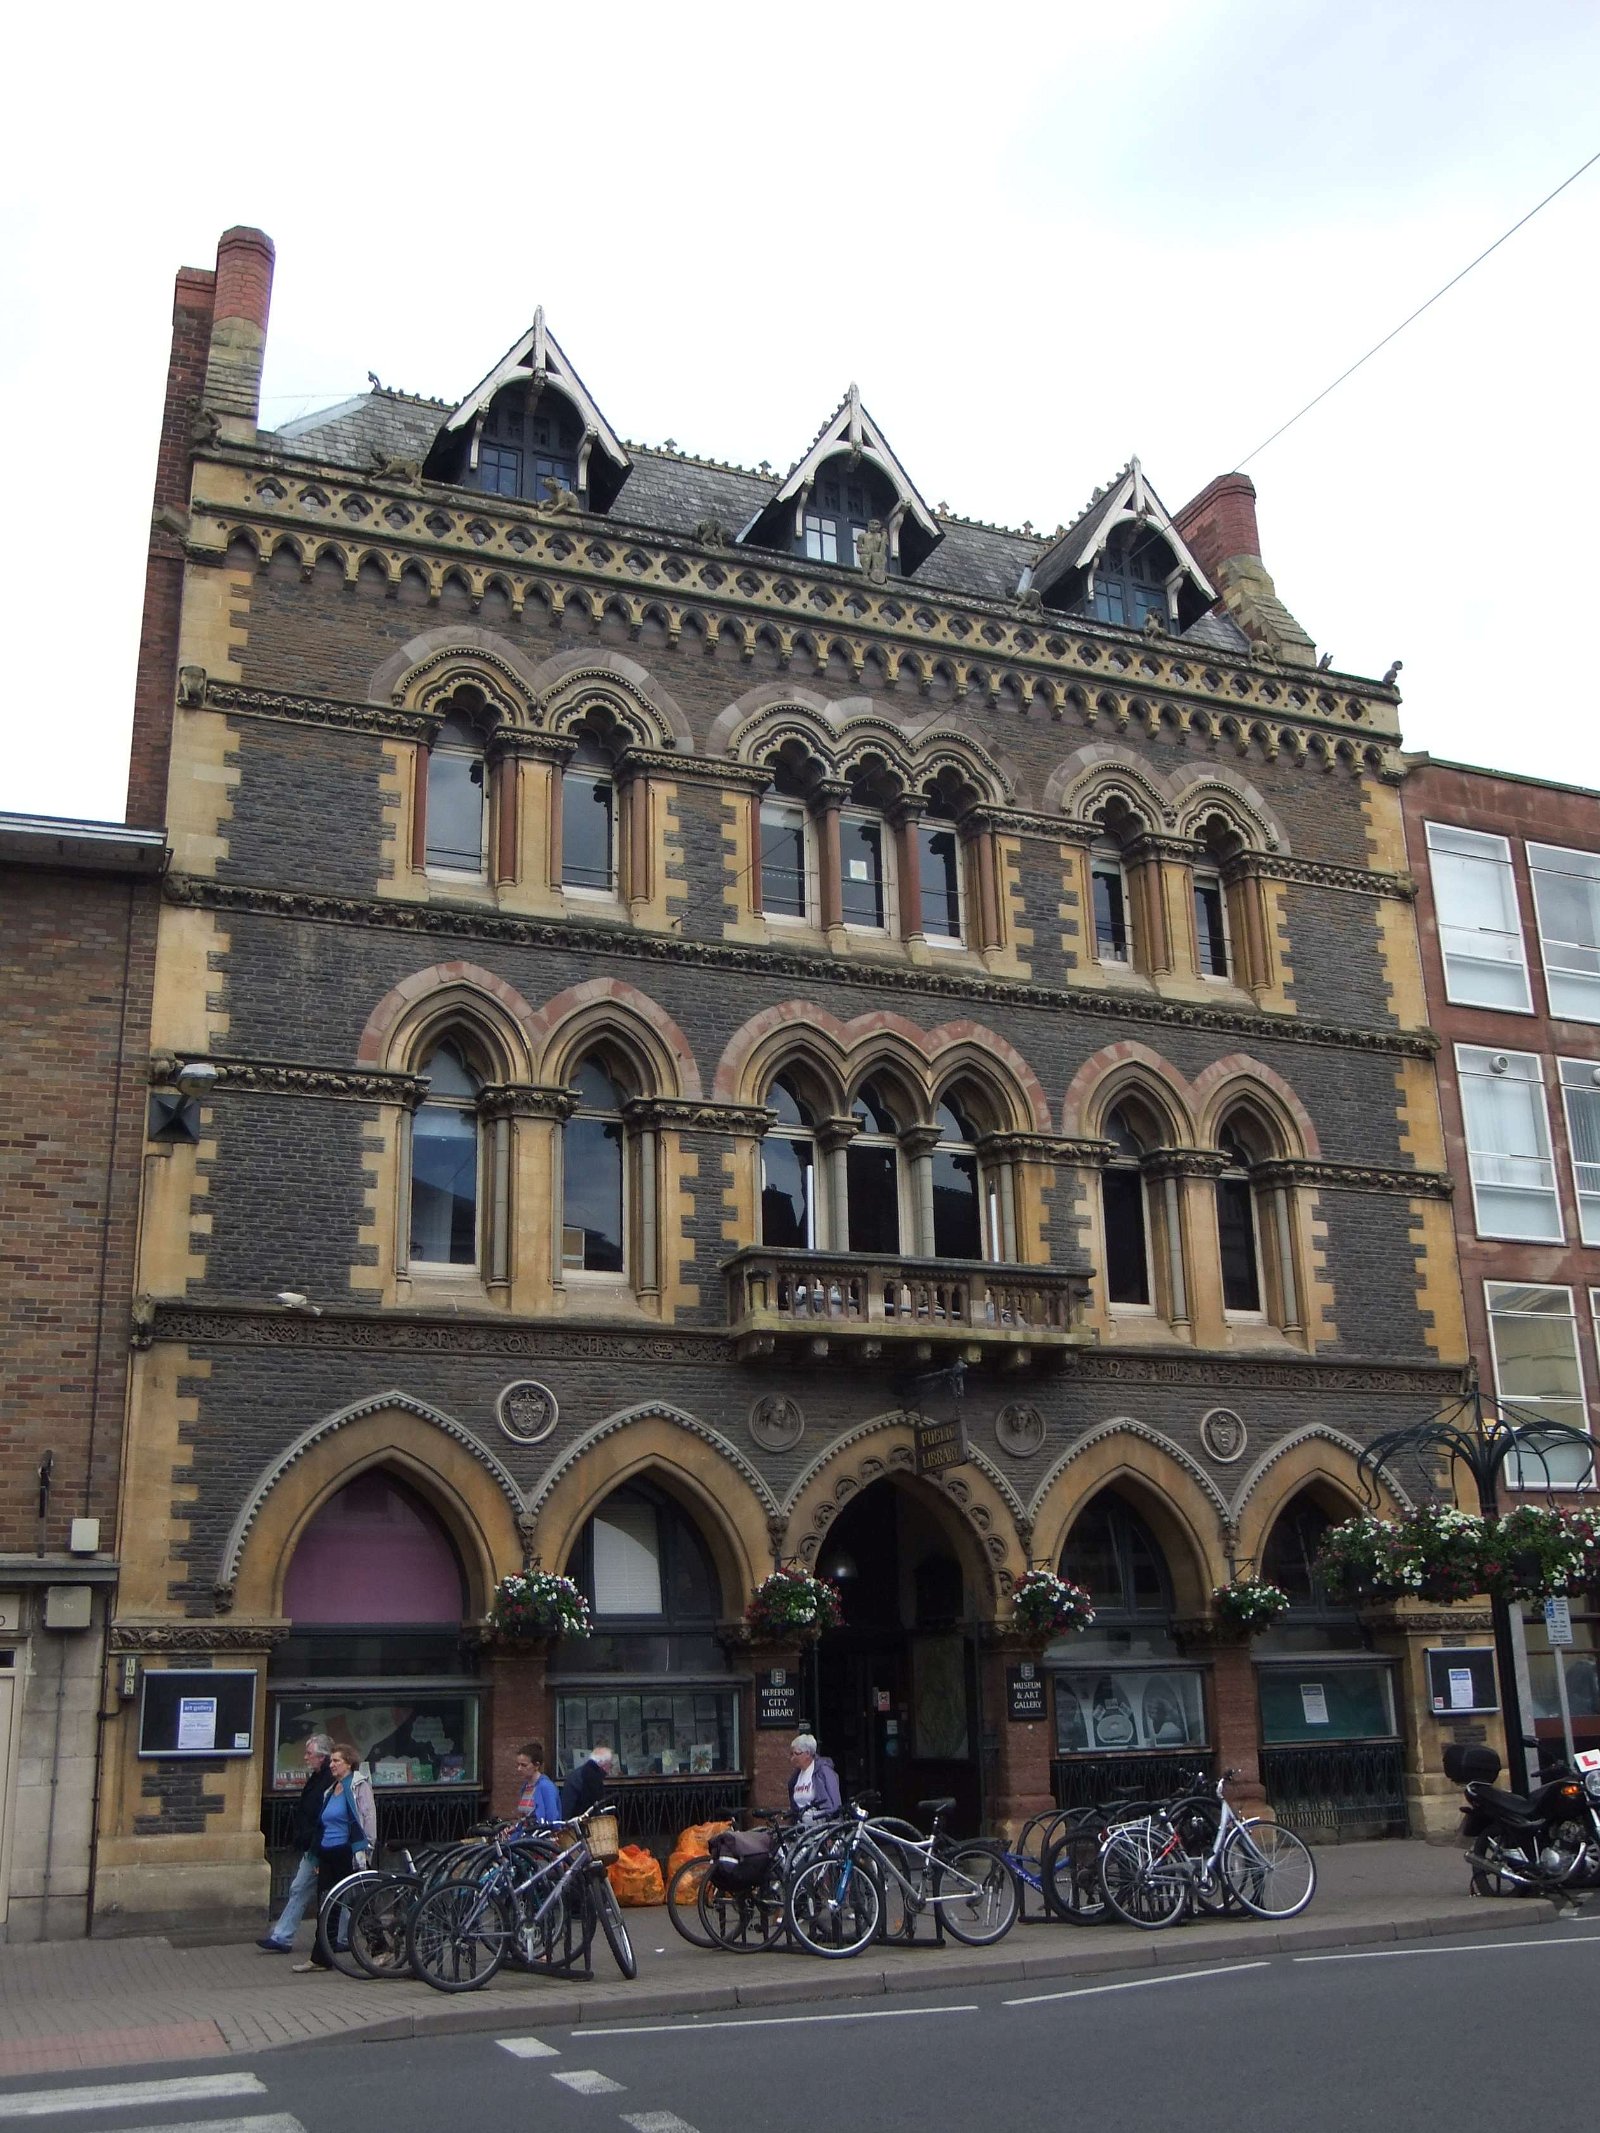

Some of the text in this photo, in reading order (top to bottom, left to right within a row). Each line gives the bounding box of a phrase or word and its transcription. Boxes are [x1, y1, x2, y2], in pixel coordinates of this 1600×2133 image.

[921, 1426, 956, 1447] PUBLIC
[922, 1448, 959, 1469] LIBRARY
[1013, 1681, 1042, 1690] MUSEUM
[761, 1688, 795, 1697] HEREFORD
[1024, 1691, 1039, 1699] ART
[768, 1698, 788, 1707] CITY
[1013, 1700, 1042, 1709] GALLERY
[762, 1708, 795, 1717] LIBRARY
[1582, 1755, 1598, 1766] L
